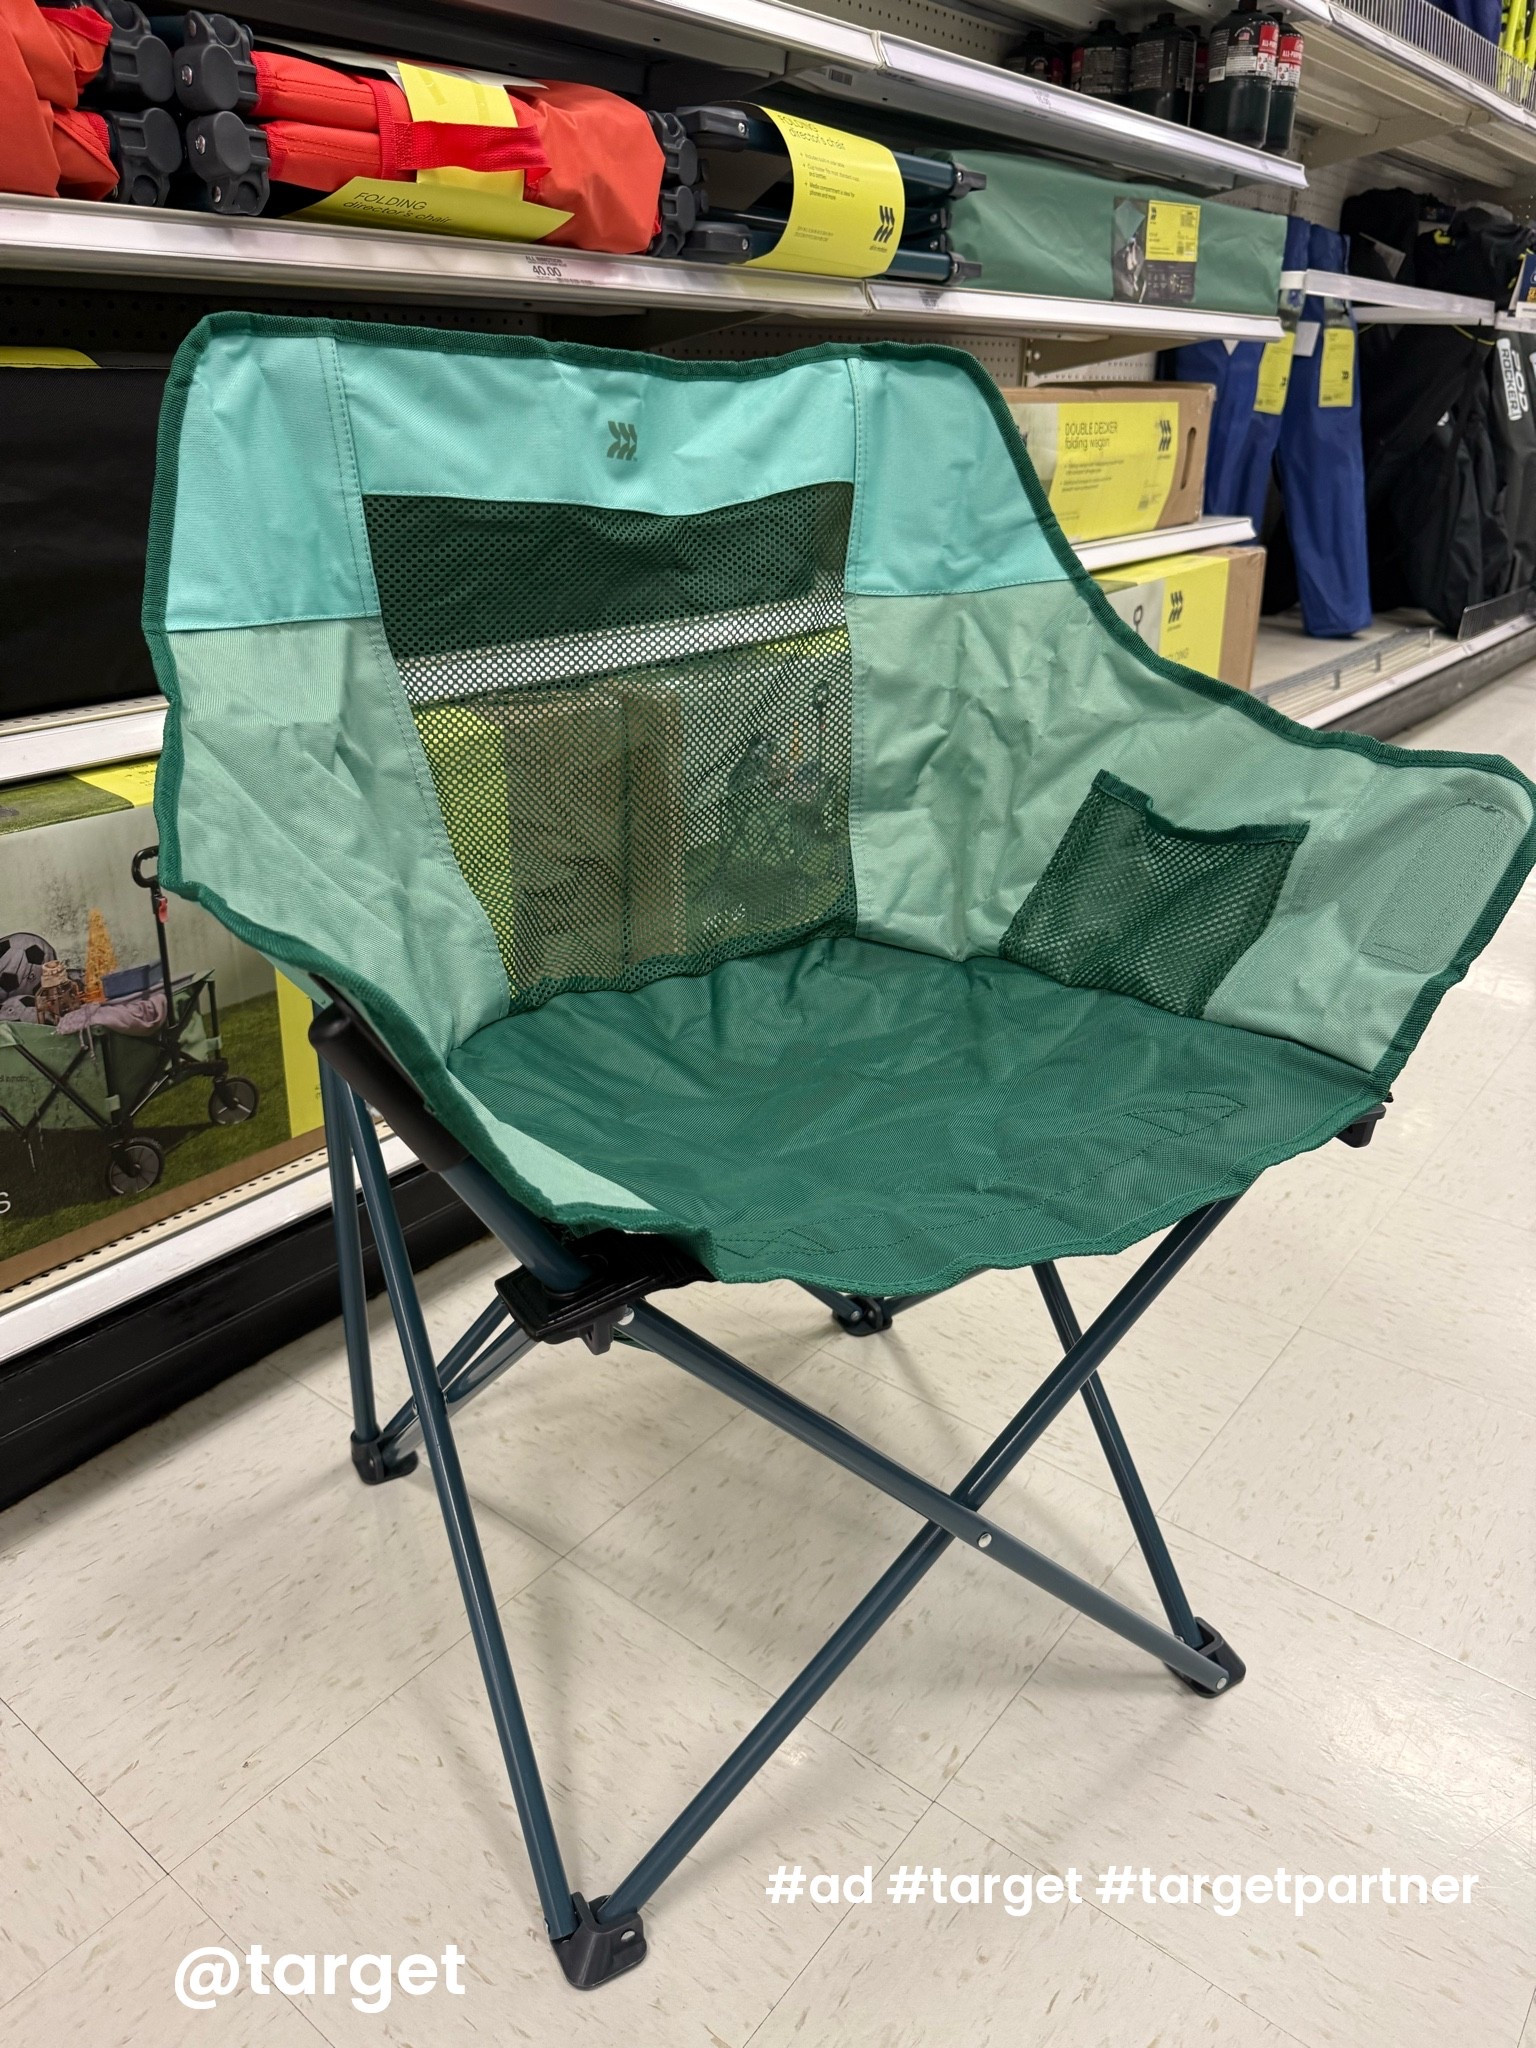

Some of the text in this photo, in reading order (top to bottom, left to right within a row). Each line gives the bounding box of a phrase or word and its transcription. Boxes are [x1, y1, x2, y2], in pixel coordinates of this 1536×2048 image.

[777, 114, 819, 133] FOLDING
[827, 137, 846, 151] chair
[353, 192, 427, 211] FOLDING
[343, 201, 453, 224] director's chair
[532, 265, 562, 277] 40.00
[1501, 349, 1518, 412] ROCKER
[1065, 421, 1118, 436] DOUBLE DECKER
[1065, 437, 1110, 452] folding wagon
